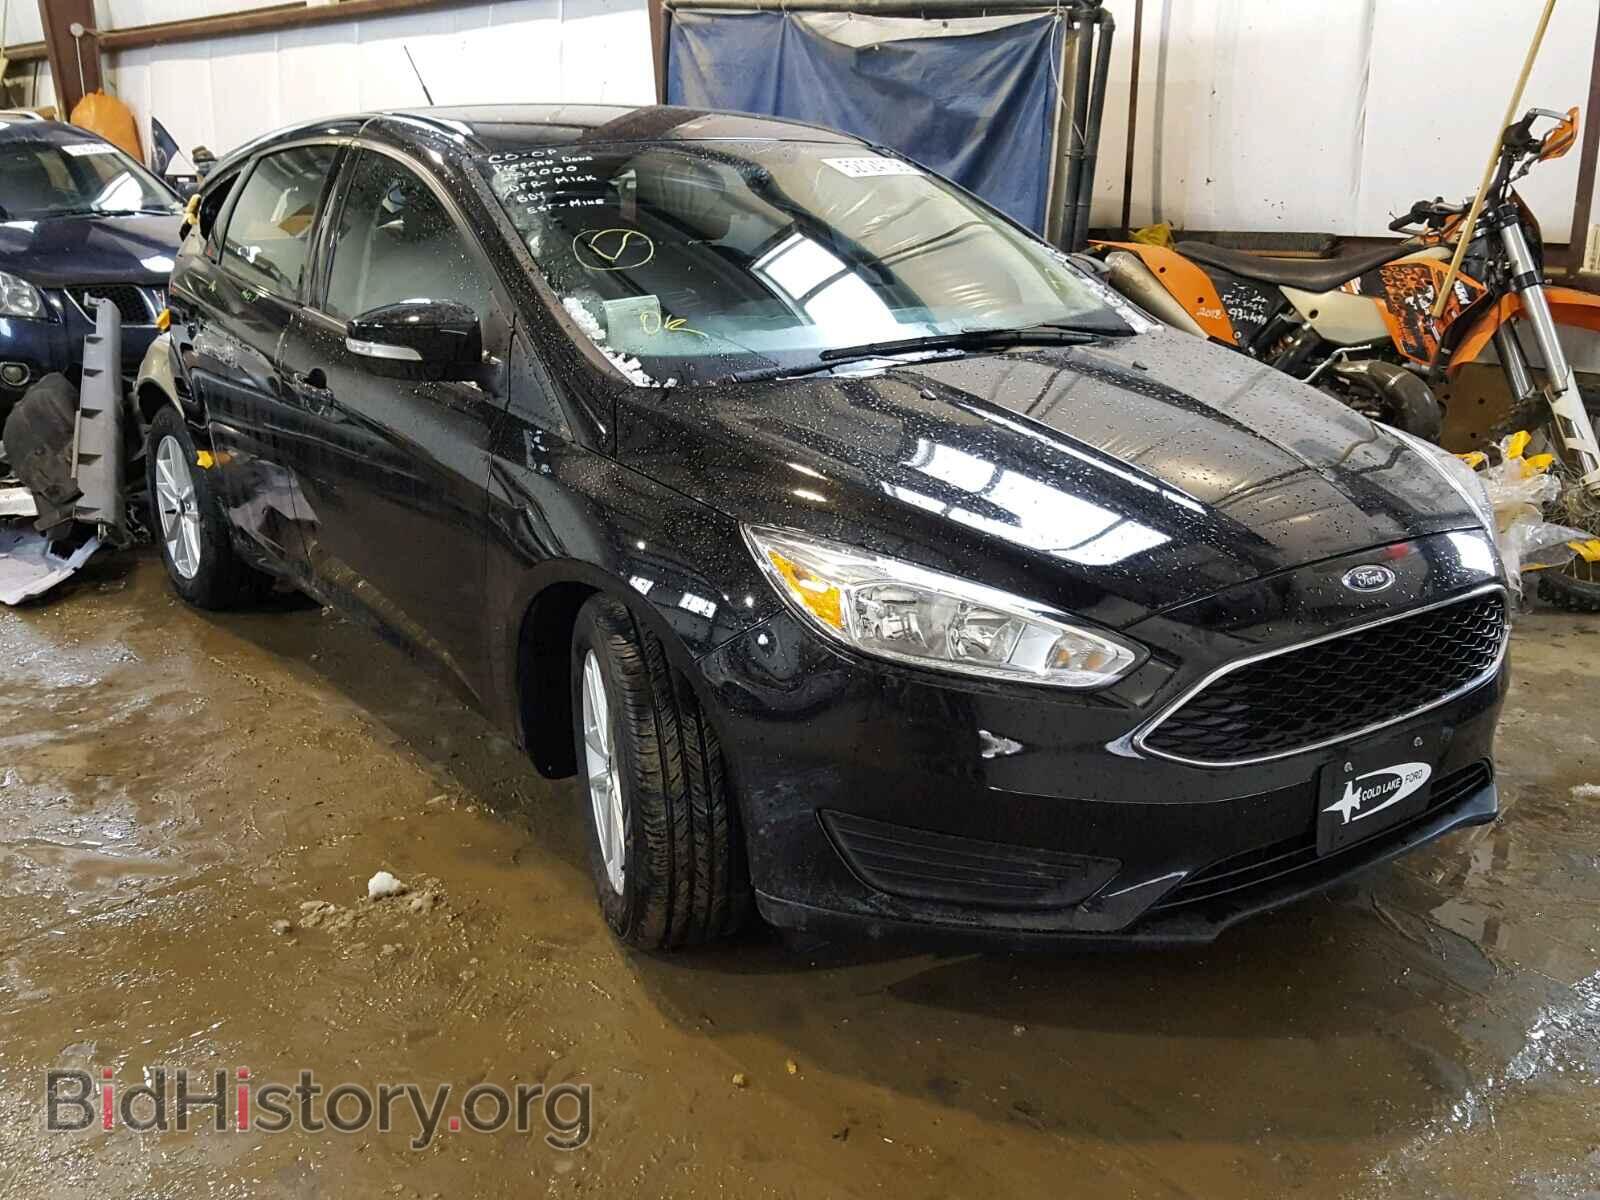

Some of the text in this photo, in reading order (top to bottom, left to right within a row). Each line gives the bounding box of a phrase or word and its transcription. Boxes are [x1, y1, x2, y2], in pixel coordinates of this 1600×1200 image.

[488, 149, 557, 163] CO-OP
[1355, 570, 1385, 586] Ford
[1362, 769, 1423, 800] COLD LAKE FORD
